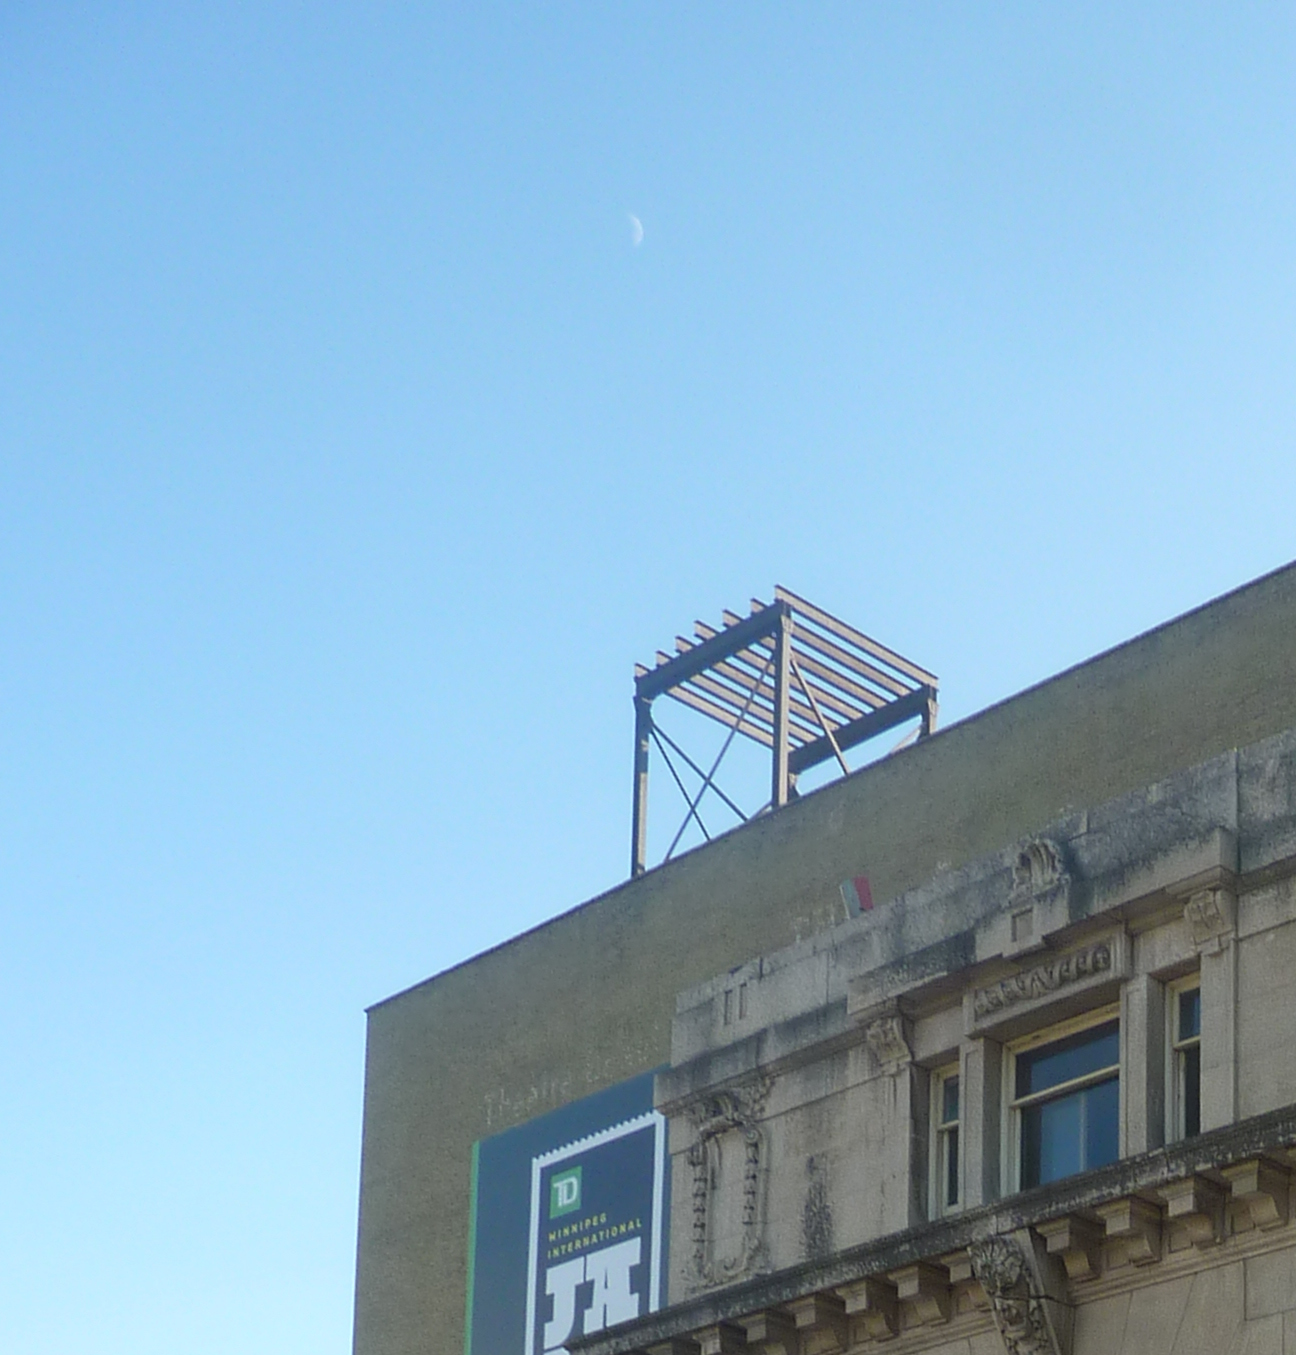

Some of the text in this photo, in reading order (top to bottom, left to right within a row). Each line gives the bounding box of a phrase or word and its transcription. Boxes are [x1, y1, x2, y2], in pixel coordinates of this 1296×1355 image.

[553, 1175, 578, 1209] TD
[546, 1217, 642, 1260] INTERNATIONAL
[548, 1212, 607, 1243] WINNIPEG
